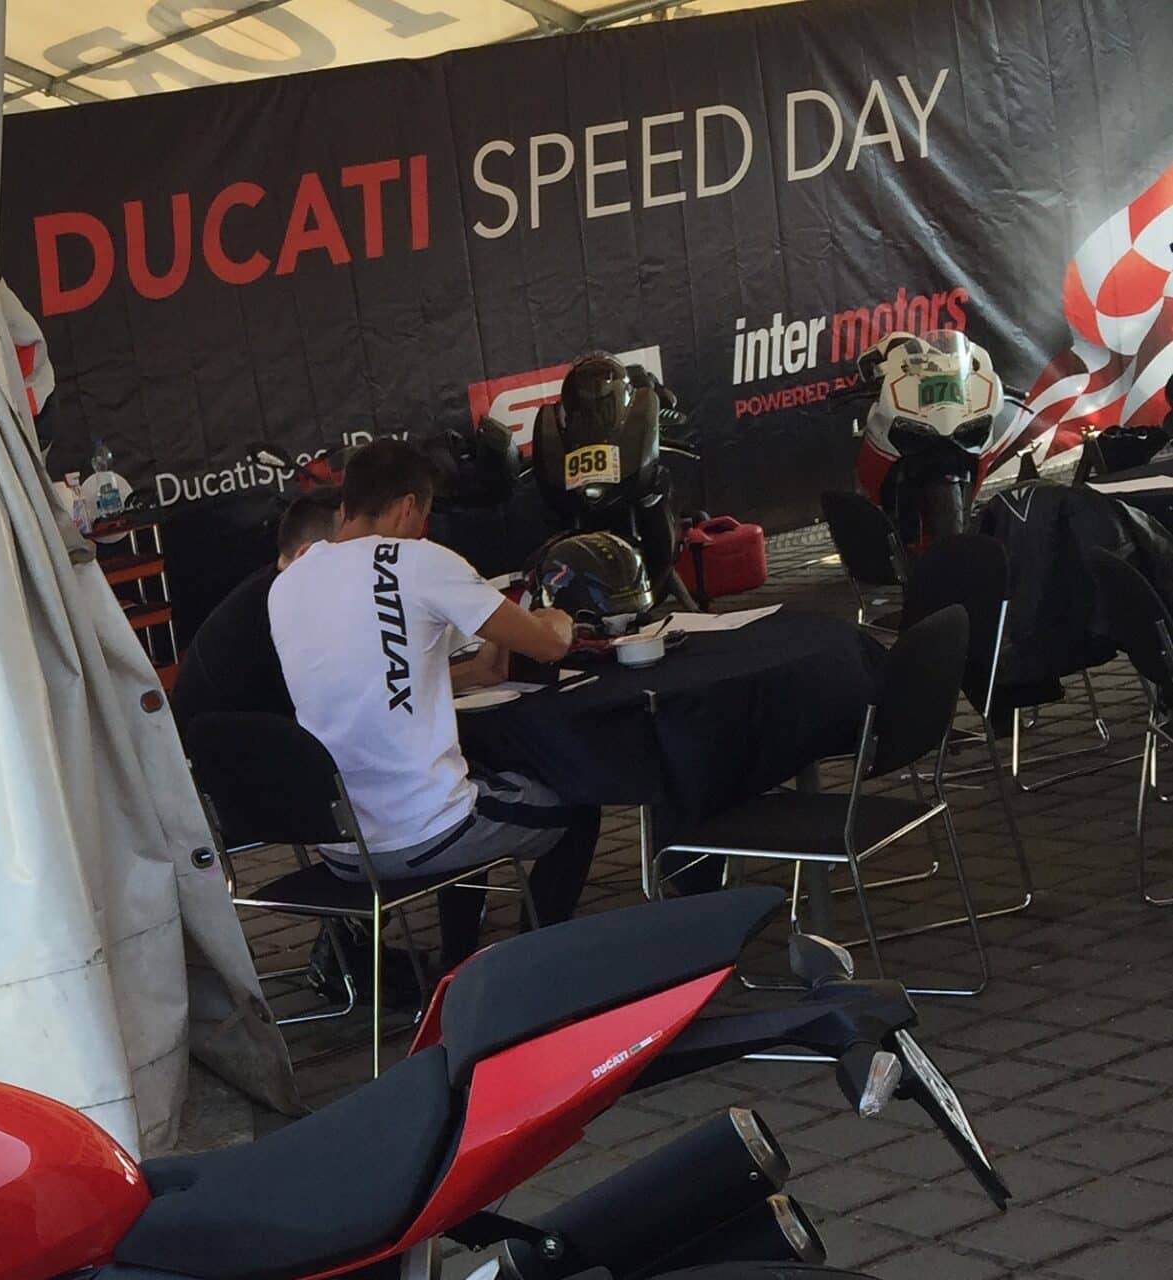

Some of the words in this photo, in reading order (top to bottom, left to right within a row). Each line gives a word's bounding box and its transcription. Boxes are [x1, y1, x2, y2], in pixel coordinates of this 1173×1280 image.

[33, 154, 430, 317] DUCATI
[472, 103, 754, 240] SPEED
[786, 68, 949, 184] DAY
[735, 380, 830, 418] POWERED
[568, 449, 607, 477] 958
[373, 542, 414, 716] BATTLAX
[591, 1050, 629, 1079] DUCATI
